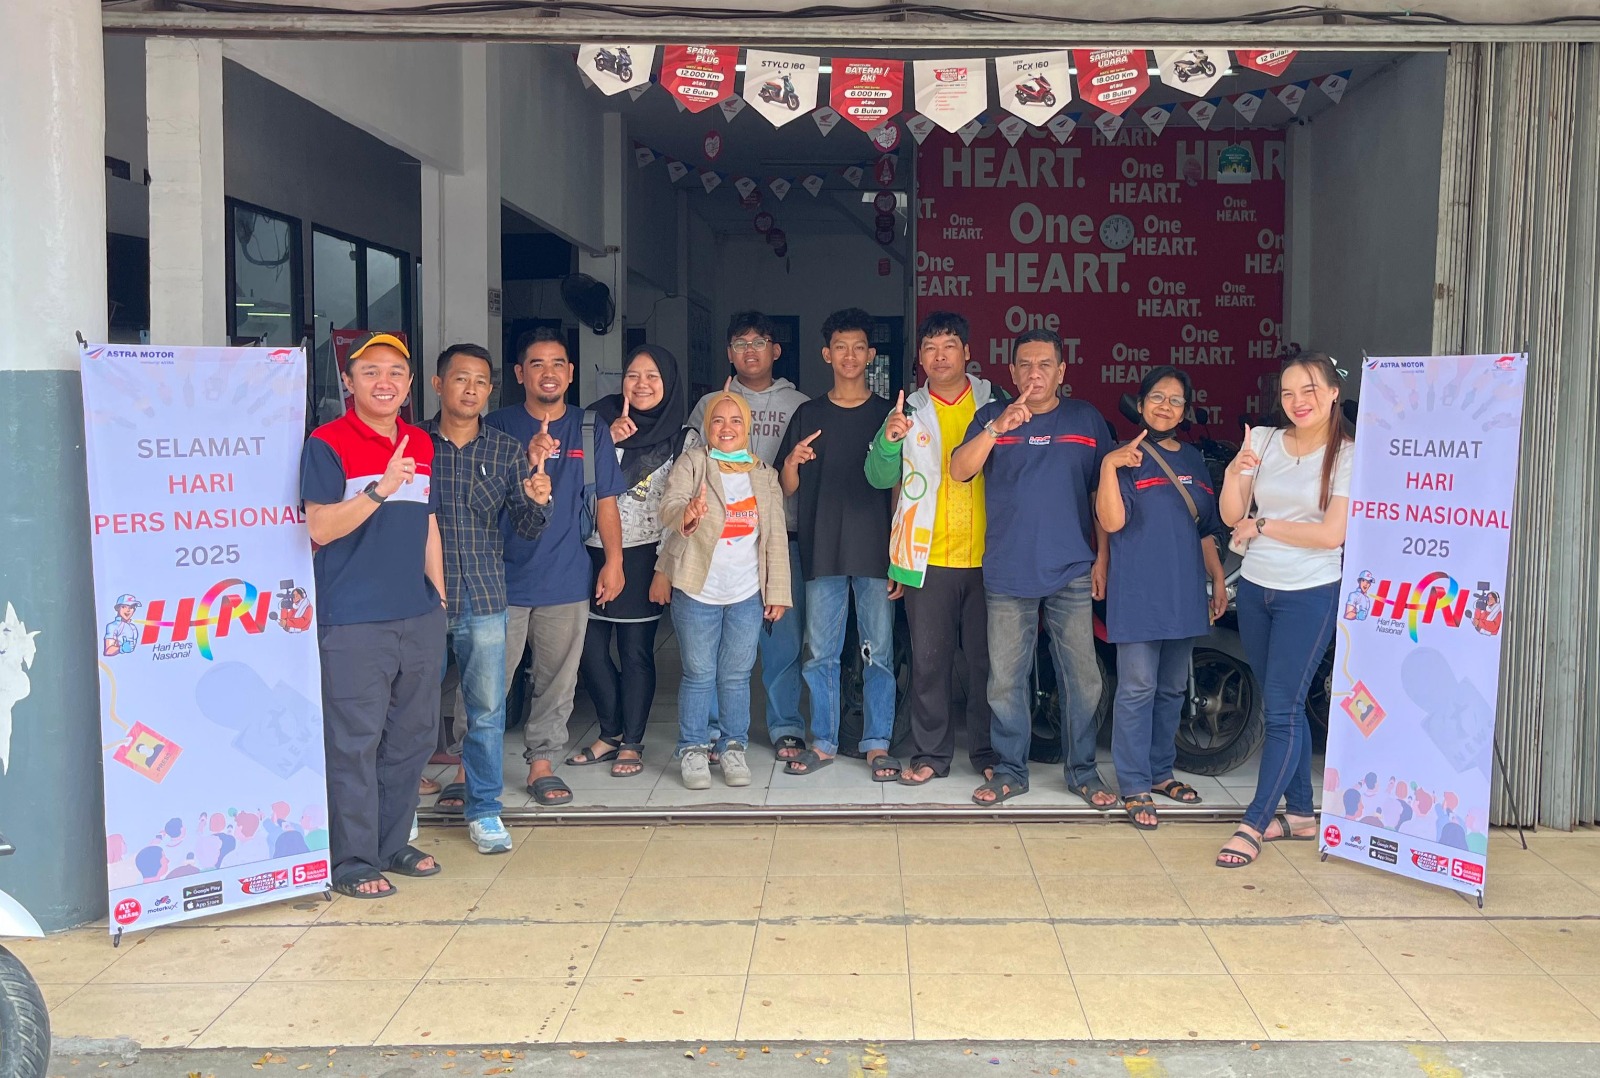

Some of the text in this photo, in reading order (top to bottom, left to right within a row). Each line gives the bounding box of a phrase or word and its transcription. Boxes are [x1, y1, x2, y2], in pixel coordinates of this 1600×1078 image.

[686, 46, 717, 56] SPARK
[1090, 48, 1133, 63] SARINGAN
[696, 55, 720, 65] PLUG
[761, 60, 806, 70] STYLO 160
[1016, 60, 1049, 71] PCX 160
[1098, 55, 1128, 68] UDARA
[1121, 71, 1134, 79] Km
[693, 88, 714, 96] Bulan
[1112, 89, 1132, 98] Bulan
[943, 147, 1086, 189] HEART.
[1121, 157, 1165, 179] One
[1109, 182, 1182, 204] HEART.
[1223, 195, 1248, 208] One
[949, 213, 974, 226] One
[1009, 202, 1095, 244] One
[1216, 209, 1257, 222] HEART.
[1143, 214, 1182, 234] One
[942, 227, 984, 240] HEART.
[1131, 236, 1198, 256] HEART.
[916, 250, 955, 272] One
[985, 252, 1131, 294] HEART.
[1148, 276, 1187, 296] One
[1222, 281, 1246, 294] One
[1136, 298, 1203, 318] HEART.
[1215, 294, 1256, 308] HEART.
[1004, 305, 1061, 334] One
[1181, 323, 1220, 343] One
[106, 350, 175, 359] ASTRA MOTOR
[1111, 342, 1150, 362] One
[1169, 346, 1236, 365] HEART.
[1401, 361, 1425, 369] MOTOR
[748, 423, 781, 438] ROR
[137, 436, 266, 459] SELAMAT
[1389, 438, 1483, 459] SELAMAT
[168, 472, 234, 495] HARI
[1406, 472, 1454, 492] HARI
[94, 504, 306, 535] PERS NASIONAL
[1351, 500, 1510, 529] PERS NASIONAL
[1402, 536, 1450, 558] 2025
[175, 543, 241, 568] 2025
[1375, 625, 1403, 636] Nasional
[1390, 619, 1406, 629] Pers
[152, 641, 193, 653] Hari Pers
[152, 650, 191, 661] Nasional
[295, 866, 307, 882] 5
[1453, 861, 1463, 877] 5
[193, 887, 209, 895] Google
[119, 901, 136, 911] AYO
